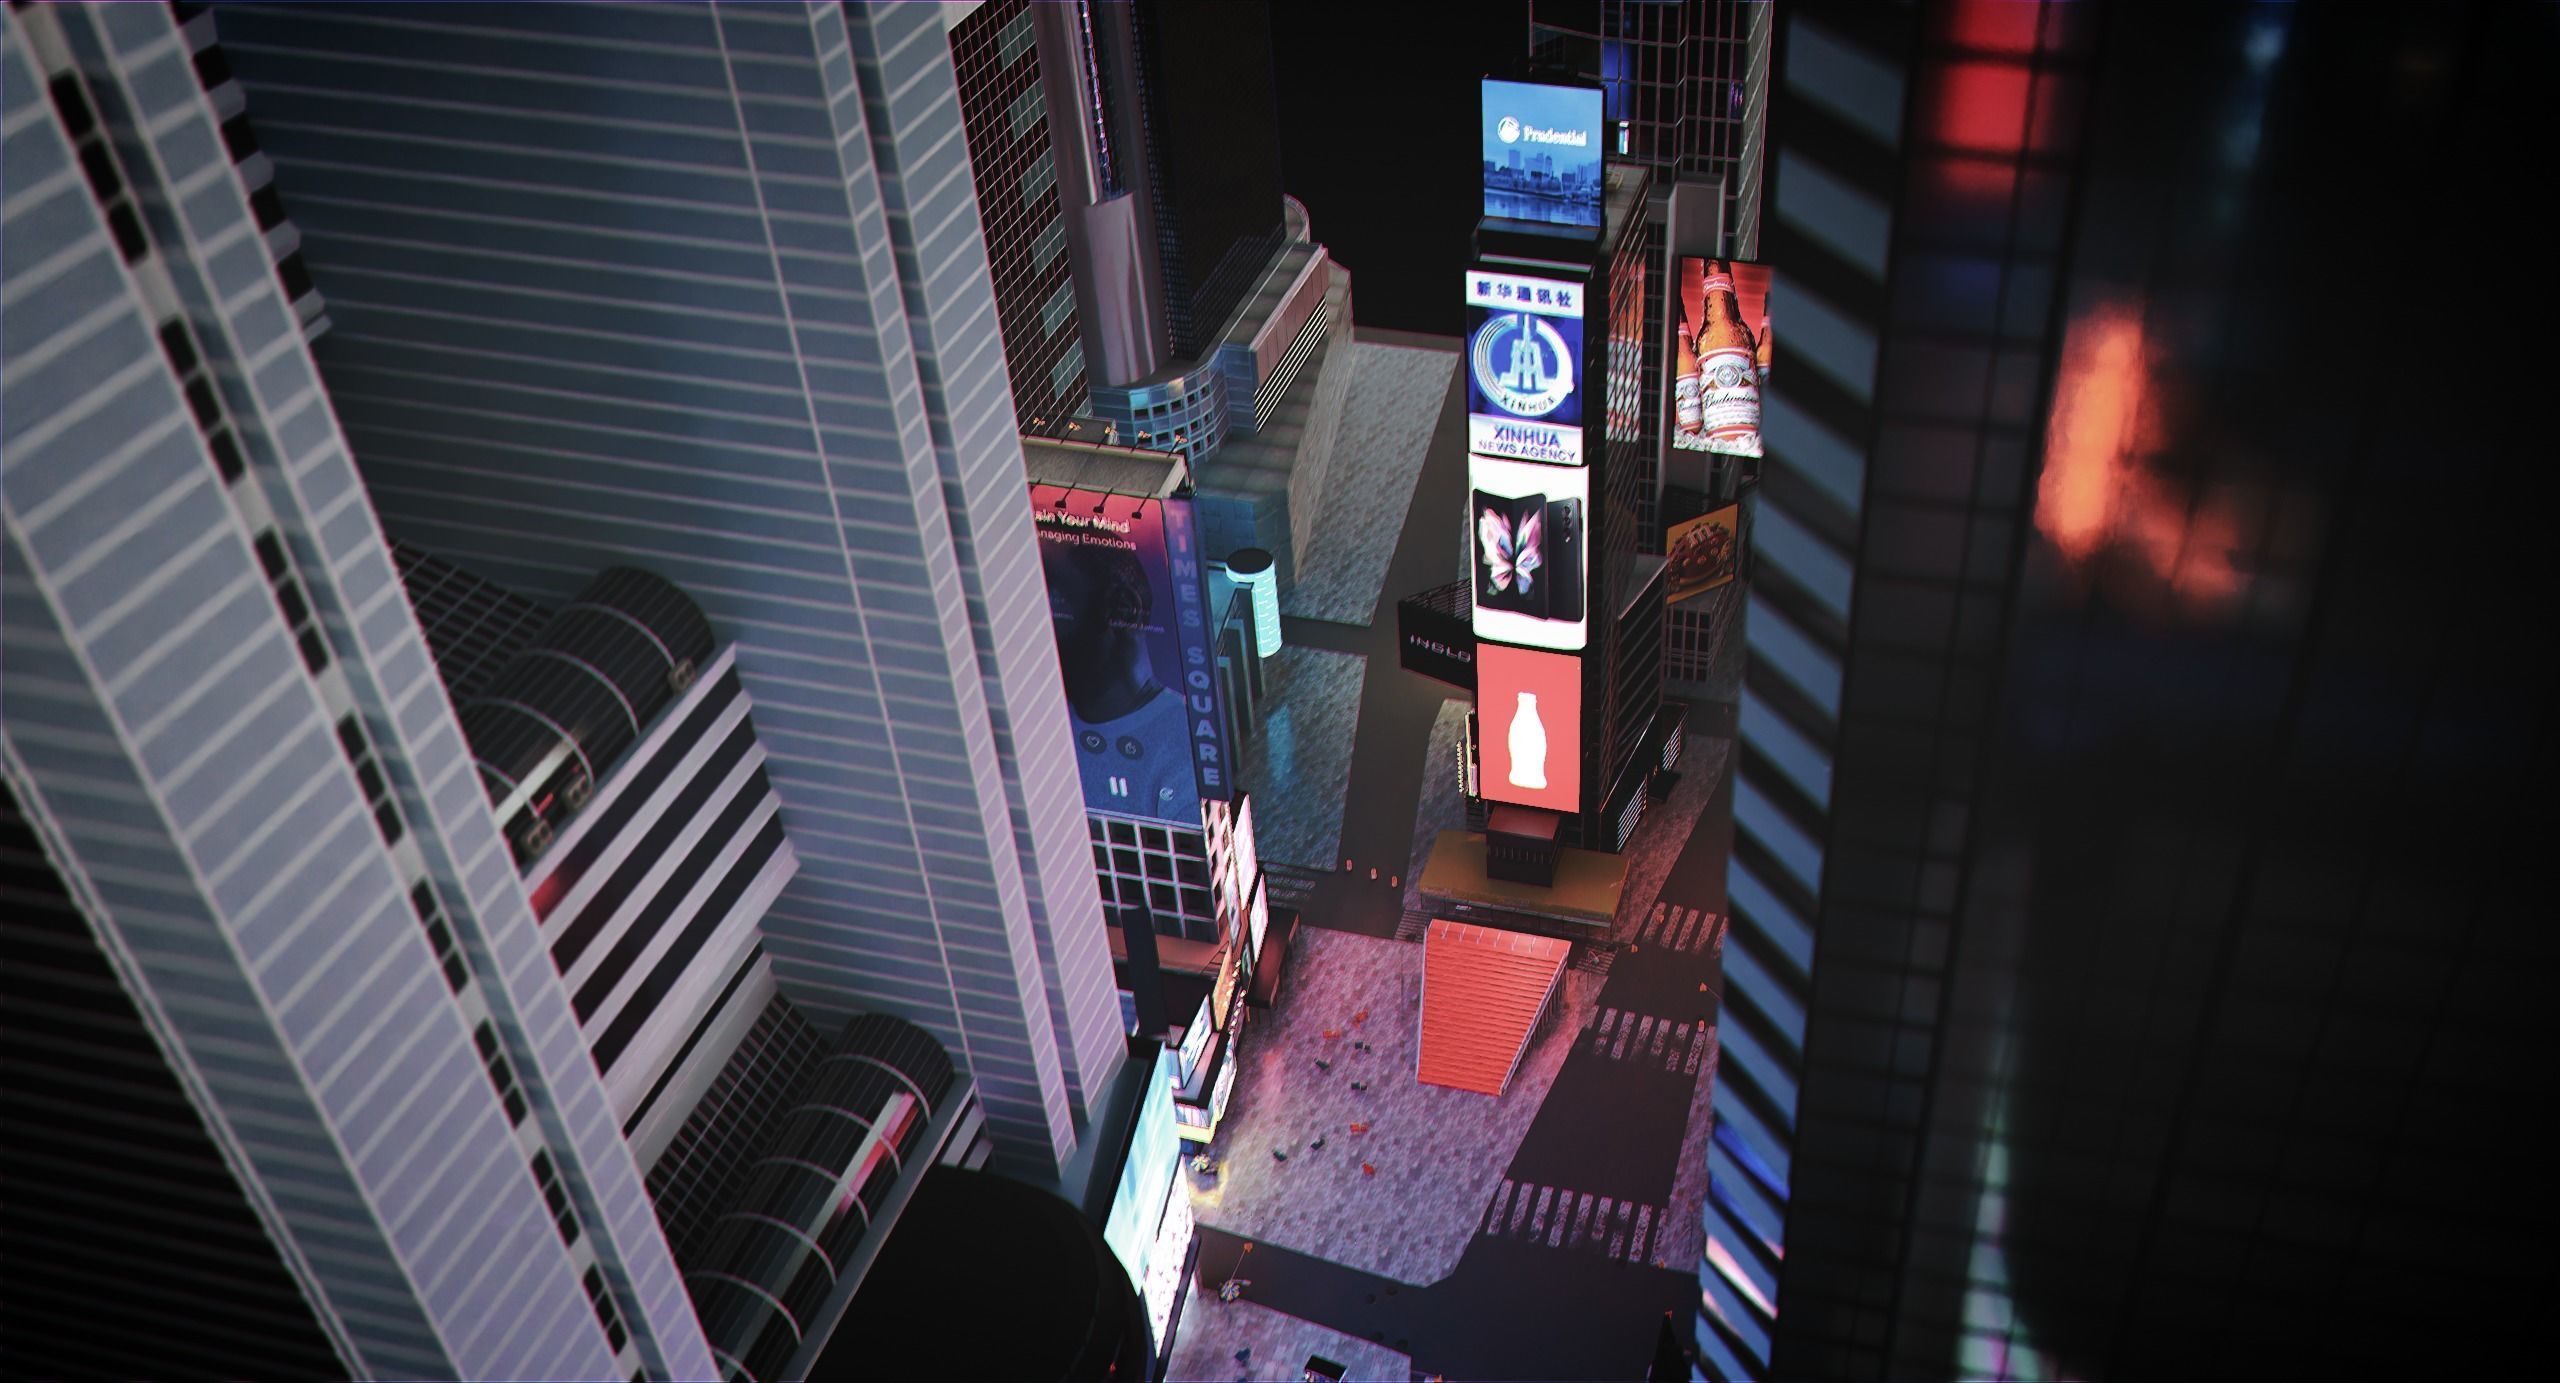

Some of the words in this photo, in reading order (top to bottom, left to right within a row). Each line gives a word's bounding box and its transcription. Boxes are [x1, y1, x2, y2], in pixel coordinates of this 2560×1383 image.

[1523, 125, 1587, 147] Prudential
[1501, 394, 1555, 411] XINHUA
[1494, 424, 1561, 447] XINHUA
[1479, 440, 1516, 454] NEWS
[1521, 445, 1575, 462] AGENCY
[1057, 511, 1090, 527] Your
[1092, 515, 1130, 533] Mind
[1038, 529, 1080, 544] naging
[1083, 533, 1136, 550] Emotions
[1171, 509, 1200, 627] TIMES
[1187, 647, 1220, 786] SQUARE
